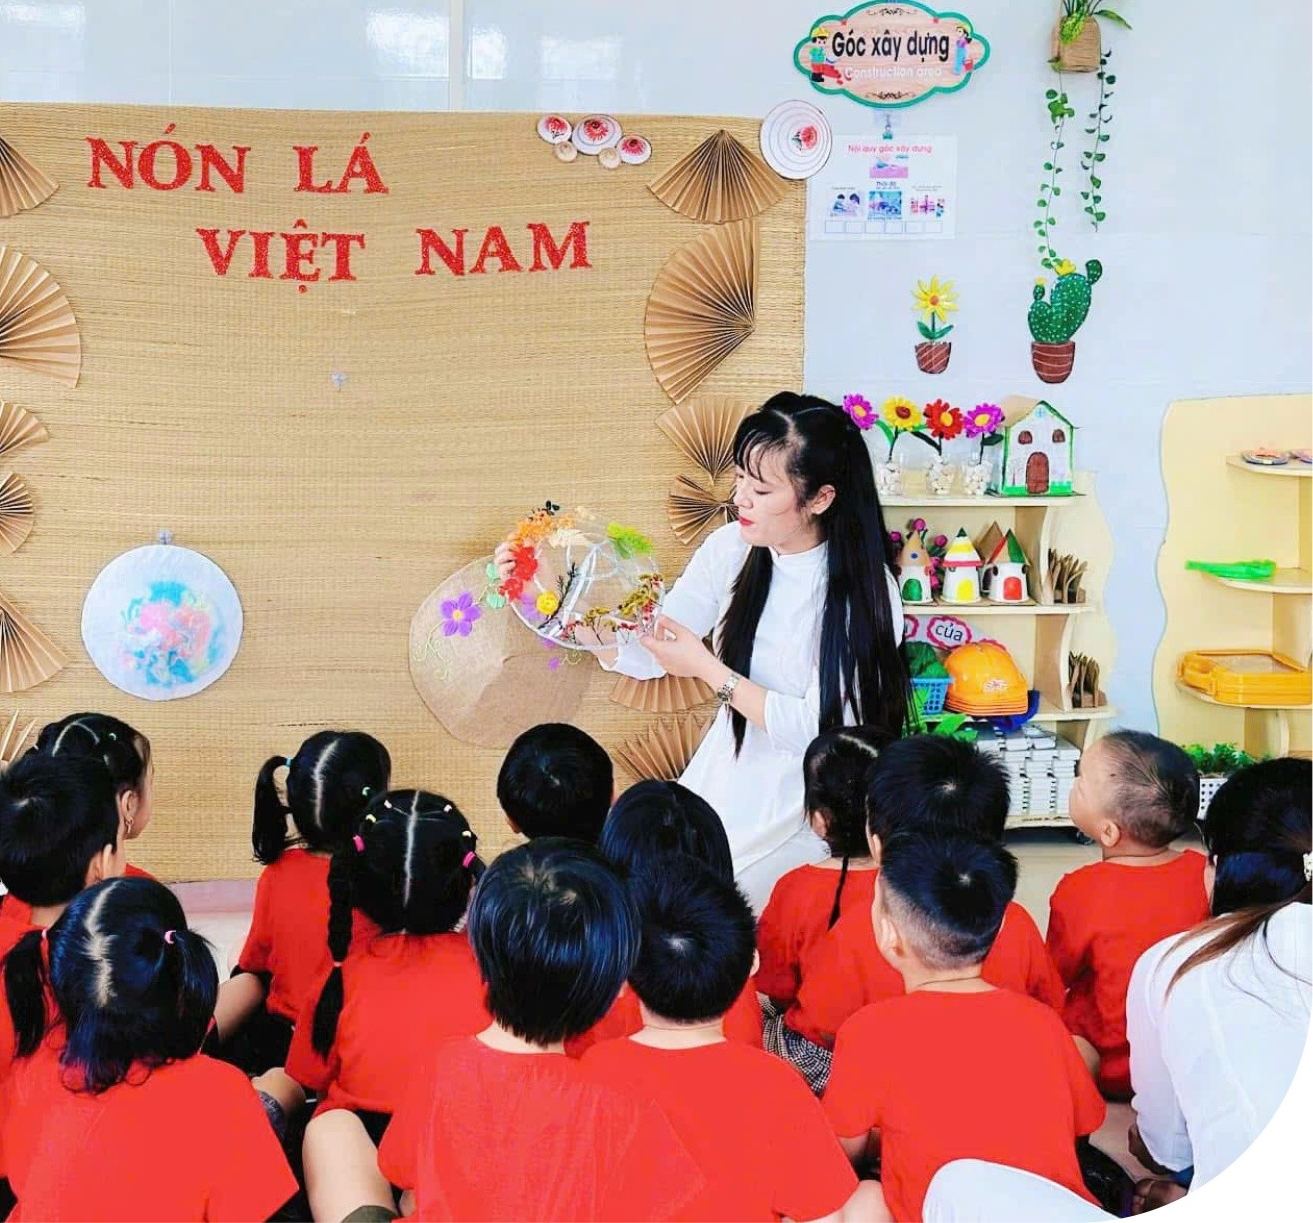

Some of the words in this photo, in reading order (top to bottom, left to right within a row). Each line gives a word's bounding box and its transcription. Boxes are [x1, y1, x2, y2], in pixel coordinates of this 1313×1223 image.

[832, 29, 866, 57] Góc
[871, 29, 902, 62] xây
[907, 31, 950, 63] dựng
[845, 66, 913, 79] Construction
[916, 66, 942, 77] area
[86, 123, 252, 194] NÓN
[293, 132, 389, 194] LÁ
[195, 219, 366, 294] VIỆT
[414, 221, 593, 276] NAM
